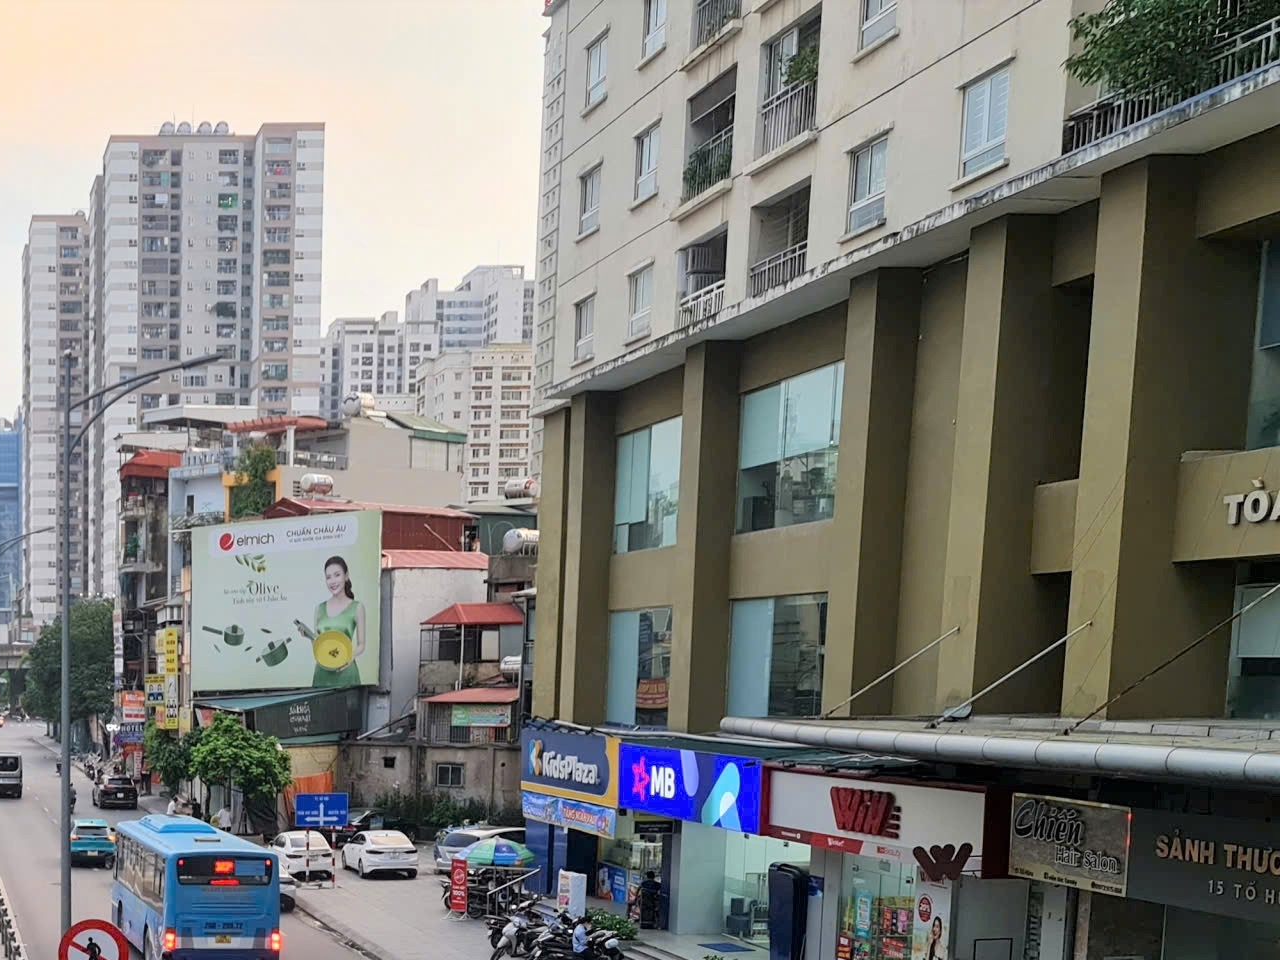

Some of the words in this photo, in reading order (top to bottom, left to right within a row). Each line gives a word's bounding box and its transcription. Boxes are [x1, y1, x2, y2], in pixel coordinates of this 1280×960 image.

[237, 533, 274, 546] elmich
[248, 582, 280, 595] Olive
[543, 751, 598, 785] KidsPlaza
[650, 765, 675, 799] MB
[1014, 799, 1082, 847] Chiến
[1054, 845, 1080, 867] Hair
[1082, 850, 1120, 874] Salon
[1156, 828, 1215, 865] SẢNH
[1208, 880, 1224, 895] 15
[1265, 888, 1280, 905] H
